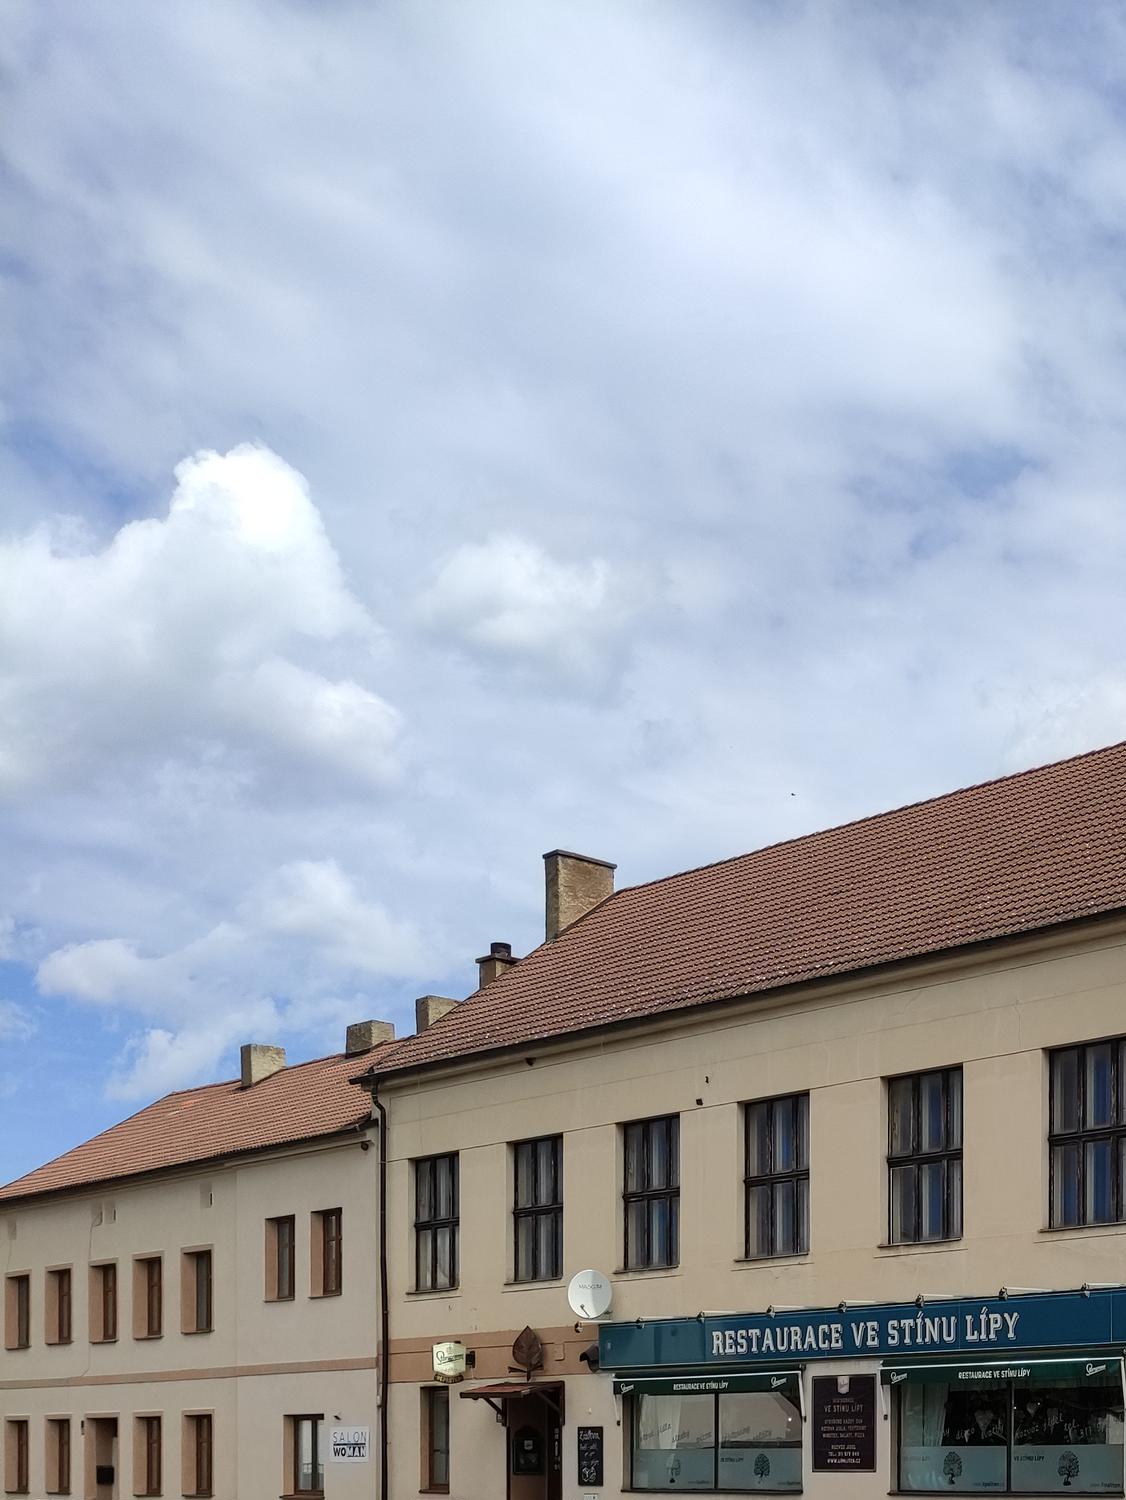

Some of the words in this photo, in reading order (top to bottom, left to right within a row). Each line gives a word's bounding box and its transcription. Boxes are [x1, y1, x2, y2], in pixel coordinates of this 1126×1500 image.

[712, 1322, 844, 1356] RESTAURACE
[850, 1320, 880, 1348] VE
[887, 1310, 957, 1346] STÍNU
[965, 1306, 1021, 1343] LÍPY
[958, 1369, 993, 1380] RESTAURACE
[993, 1370, 1000, 1379] VE
[1000, 1367, 1017, 1379] STÍNU
[1017, 1366, 1031, 1378] LÍPY
[333, 1432, 366, 1443] SALON
[333, 1446, 366, 1458] WOMAN
